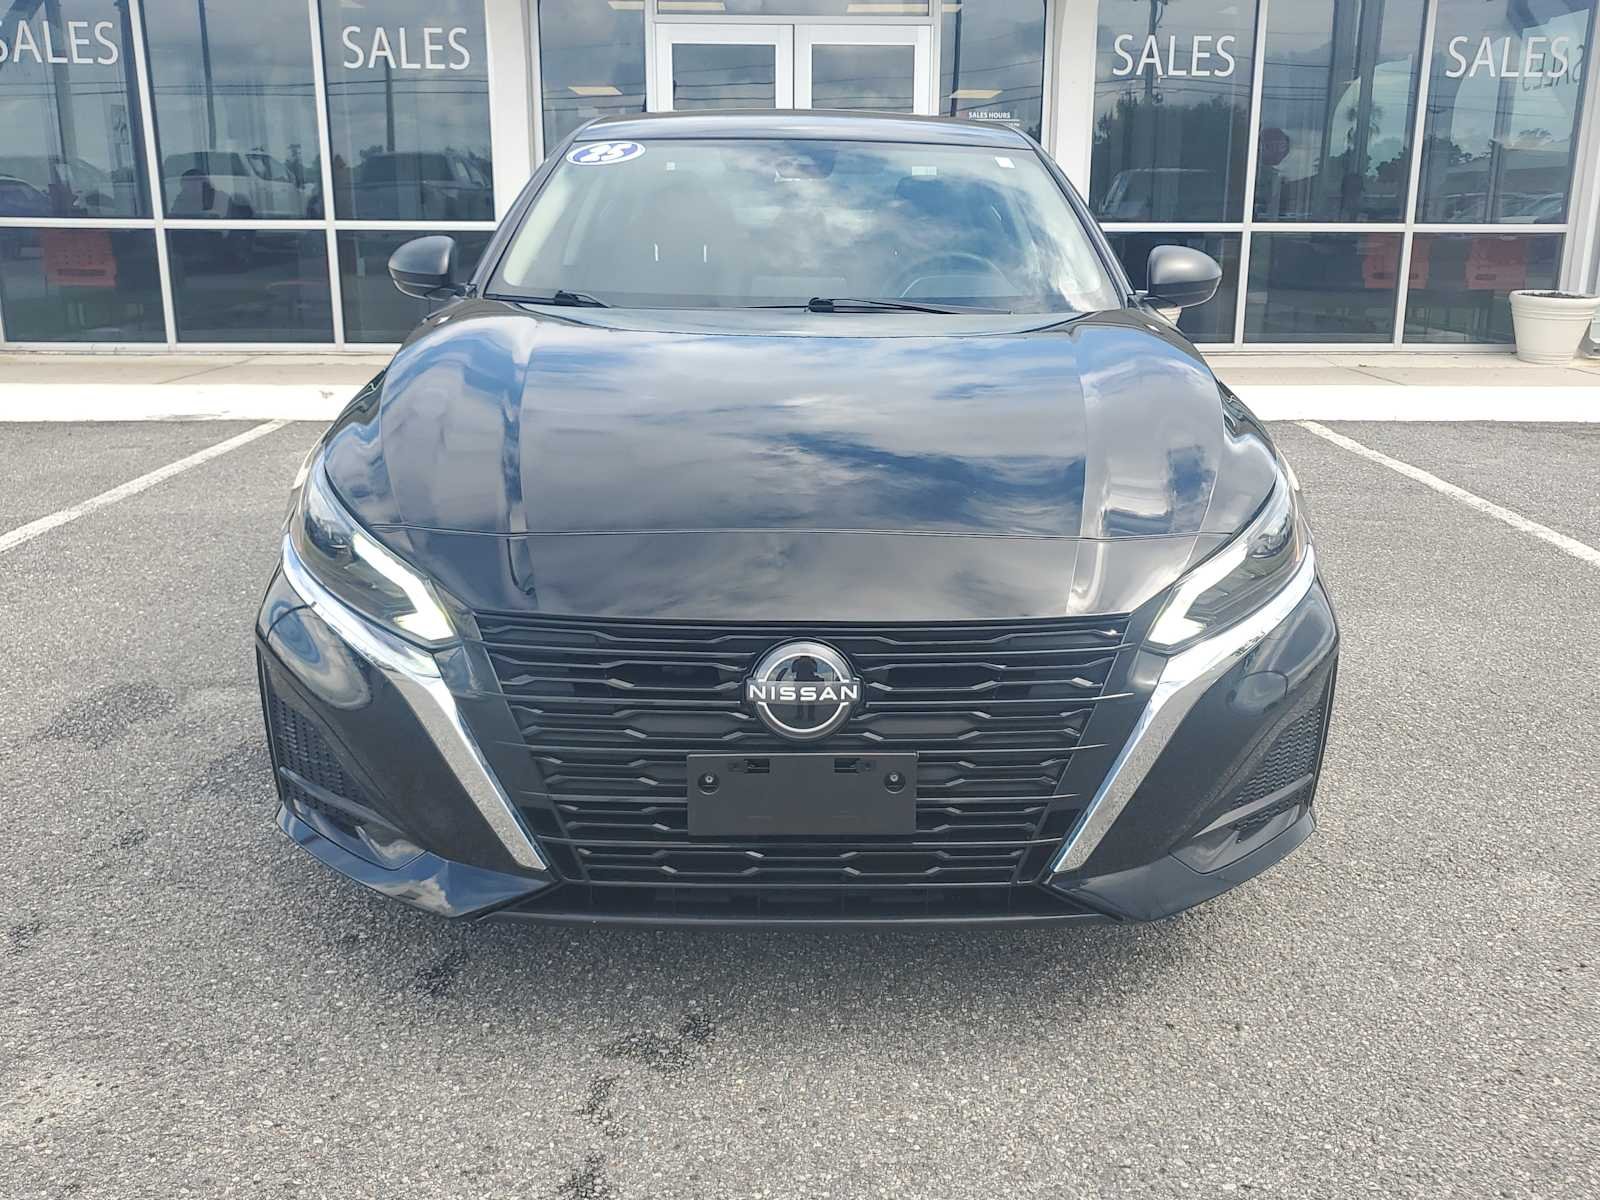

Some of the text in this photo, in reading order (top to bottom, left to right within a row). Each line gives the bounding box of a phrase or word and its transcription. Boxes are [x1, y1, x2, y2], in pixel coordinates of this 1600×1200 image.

[342, 25, 470, 70] SALES
[1112, 33, 1236, 77] SALES
[1445, 35, 1569, 78] SALES
[968, 111, 1010, 119] SALES HOURS
[580, 143, 633, 162] 25
[749, 684, 858, 701] NISSAN
